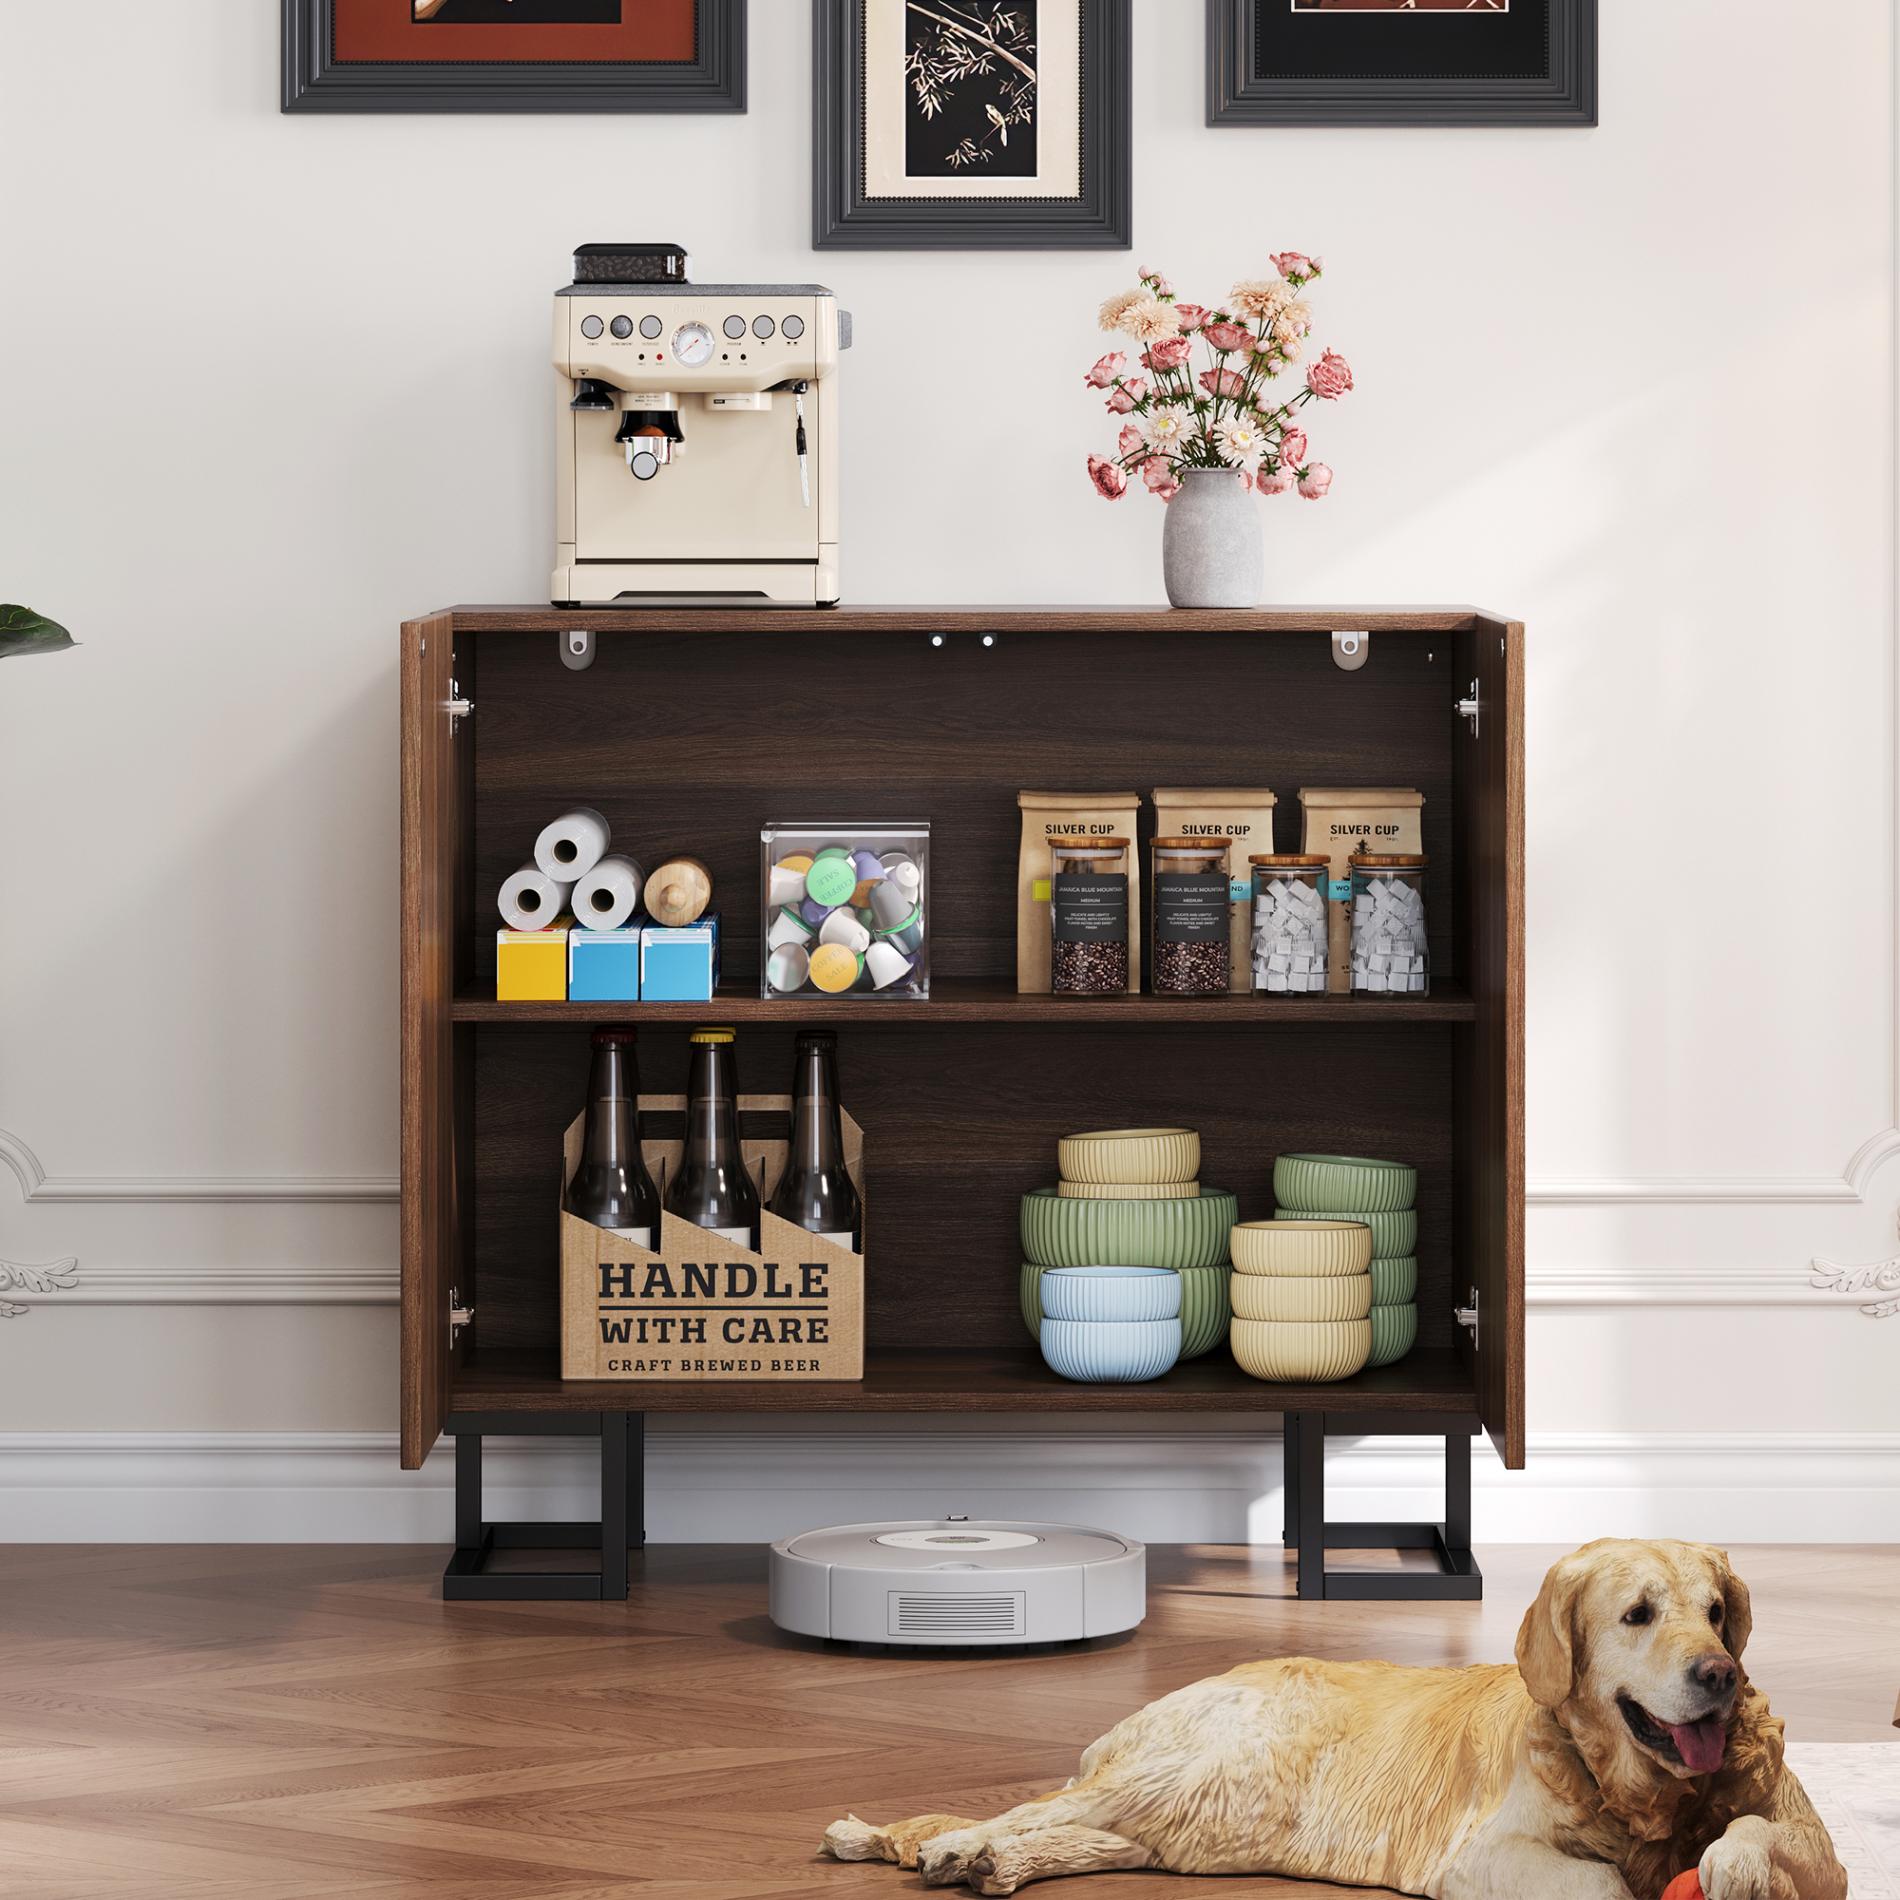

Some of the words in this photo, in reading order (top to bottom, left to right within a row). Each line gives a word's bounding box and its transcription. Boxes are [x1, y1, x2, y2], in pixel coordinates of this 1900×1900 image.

[1045, 824, 1086, 834] SILVER
[1090, 824, 1115, 834] CUP
[1182, 824, 1222, 835] SILVER
[1226, 825, 1251, 835] CUP
[1330, 824, 1371, 835] SILVER
[1375, 825, 1400, 835] CUP
[598, 1263, 828, 1298] HANDLE
[599, 1318, 707, 1343] WITH
[722, 1318, 829, 1343] CARE
[608, 1359, 672, 1371] CRAFT
[681, 1359, 762, 1371] BREWED
[771, 1359, 820, 1371] BEER
